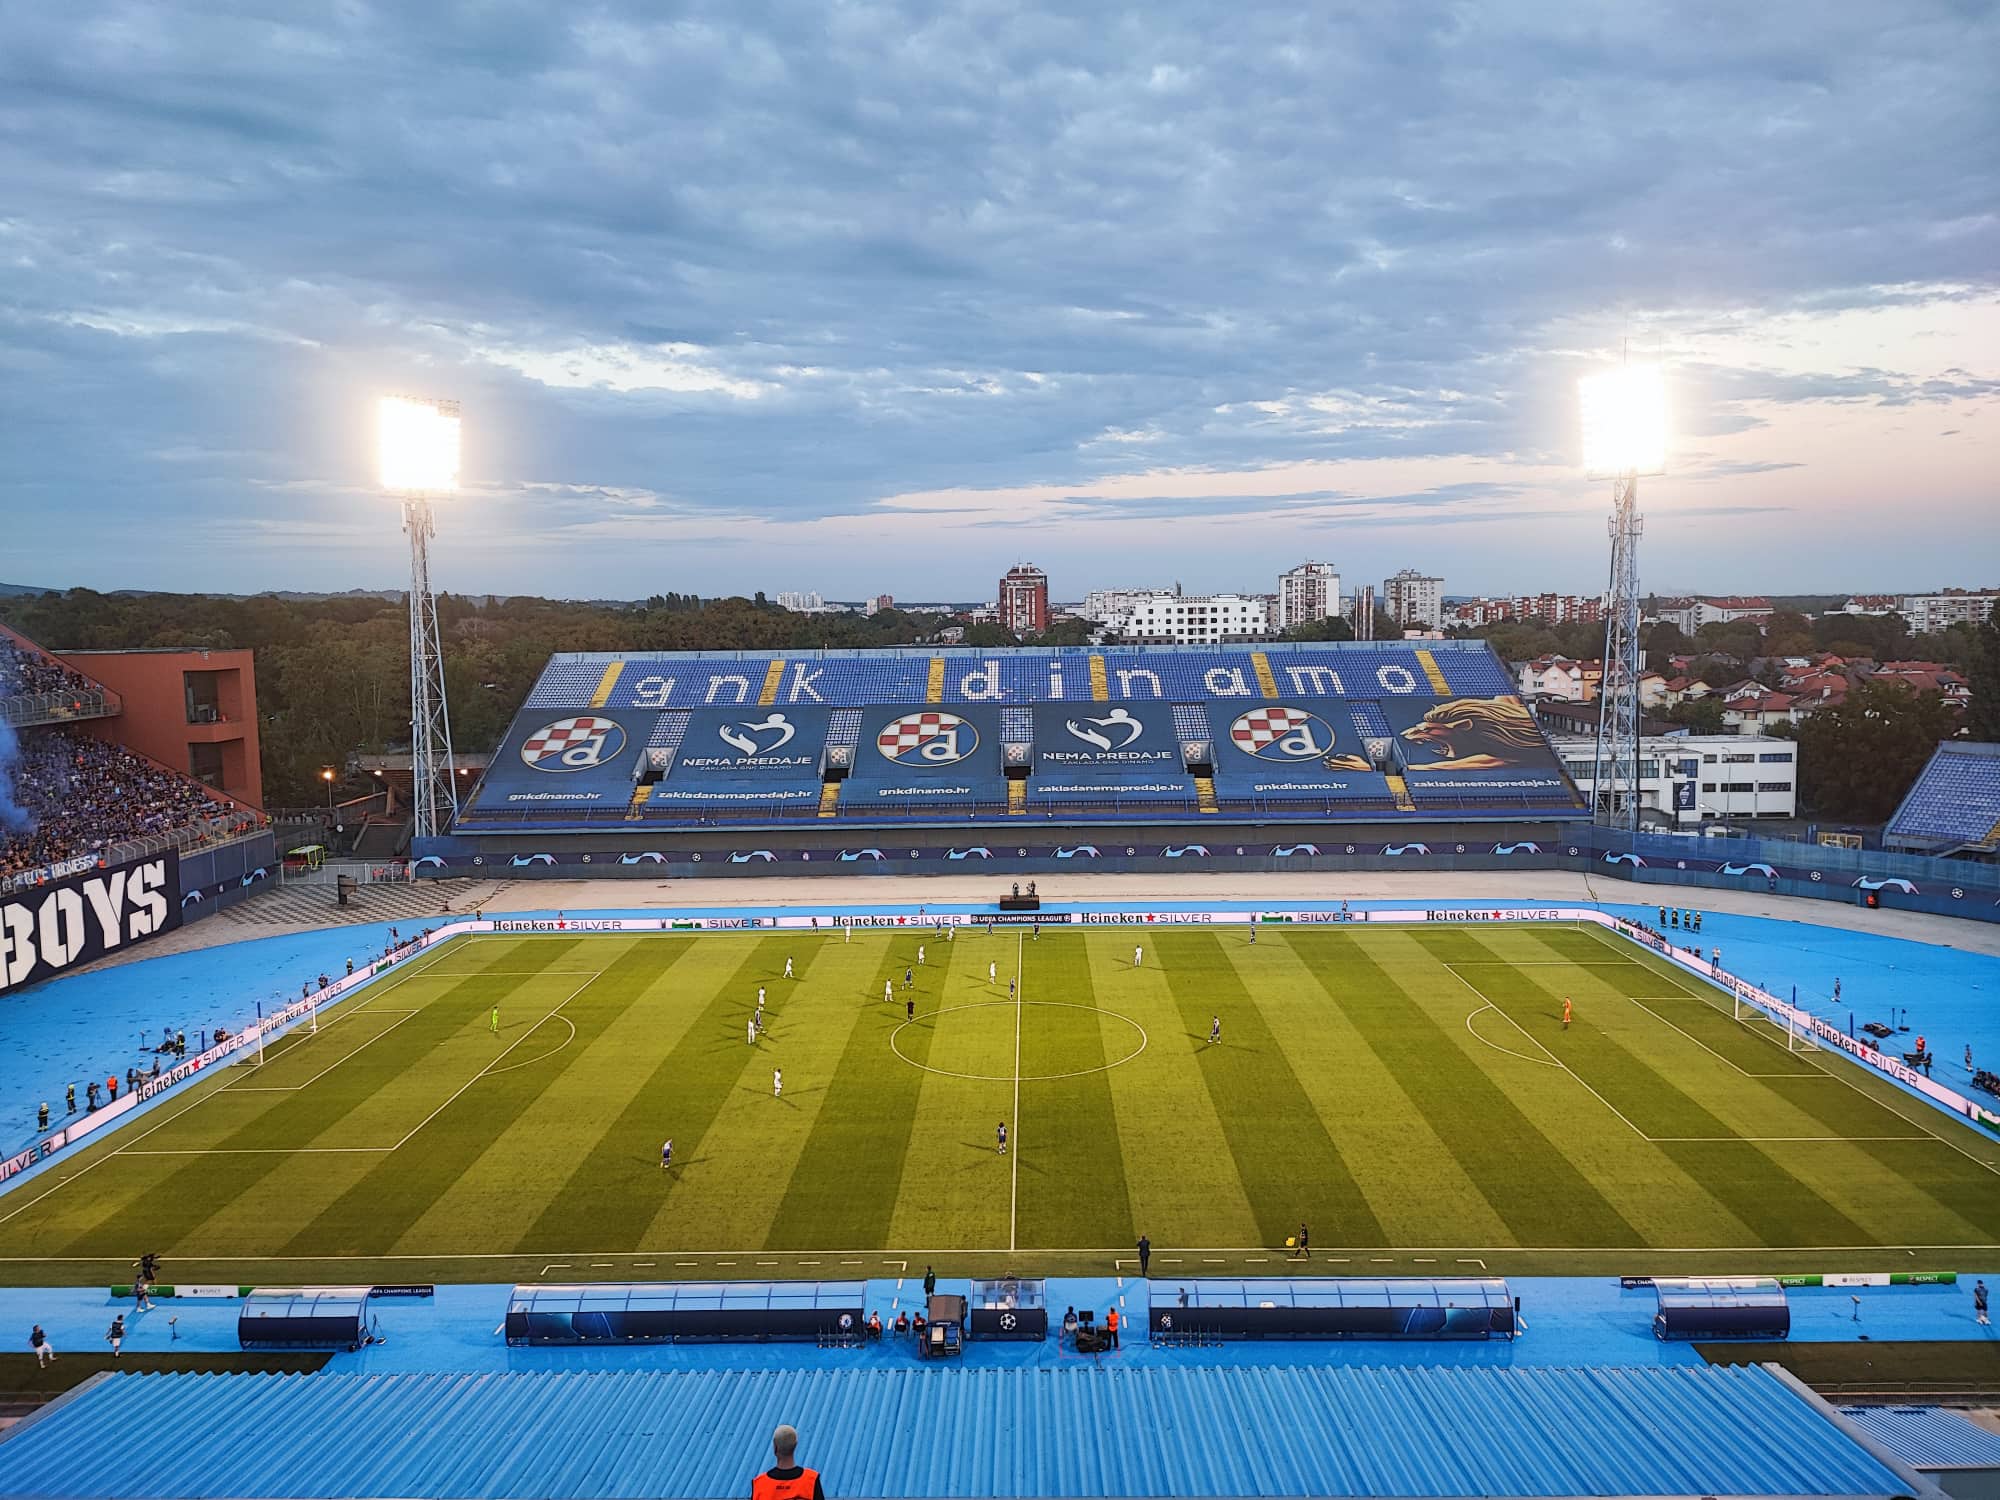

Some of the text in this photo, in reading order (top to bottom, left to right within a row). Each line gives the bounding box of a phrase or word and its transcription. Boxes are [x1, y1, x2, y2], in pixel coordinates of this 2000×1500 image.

[632, 660, 1417, 707] gnk dinamo
[1042, 751, 1173, 760] NEMA PREDAJE
[682, 757, 813, 766] NEMA PREDAJE
[1038, 784, 1184, 792] zakladanemapredaje.hr
[1254, 782, 1348, 792] gnkdinamo.hr
[1412, 779, 1561, 788] zakladanemapredaje.hr
[508, 792, 602, 801] gnkdinamo.hr
[658, 790, 812, 800] zakladanemapredaje.hr
[879, 787, 971, 796] gnkdinamo.hr
[1081, 913, 1212, 924] Heineken SILVER
[1300, 912, 1353, 922] SILVER
[1426, 910, 1559, 921] Heineken SILVER
[0, 859, 168, 989] BOYS
[492, 920, 623, 931] Heineken SILVER
[709, 918, 762, 928] SILVER
[832, 916, 962, 928] Heineken SILVER
[395, 941, 422, 962] SILVER
[1809, 1017, 1918, 1086] Heineken SILVER
[136, 1035, 244, 1106] Heineken SILVER
[0, 1141, 51, 1180] ILVER
